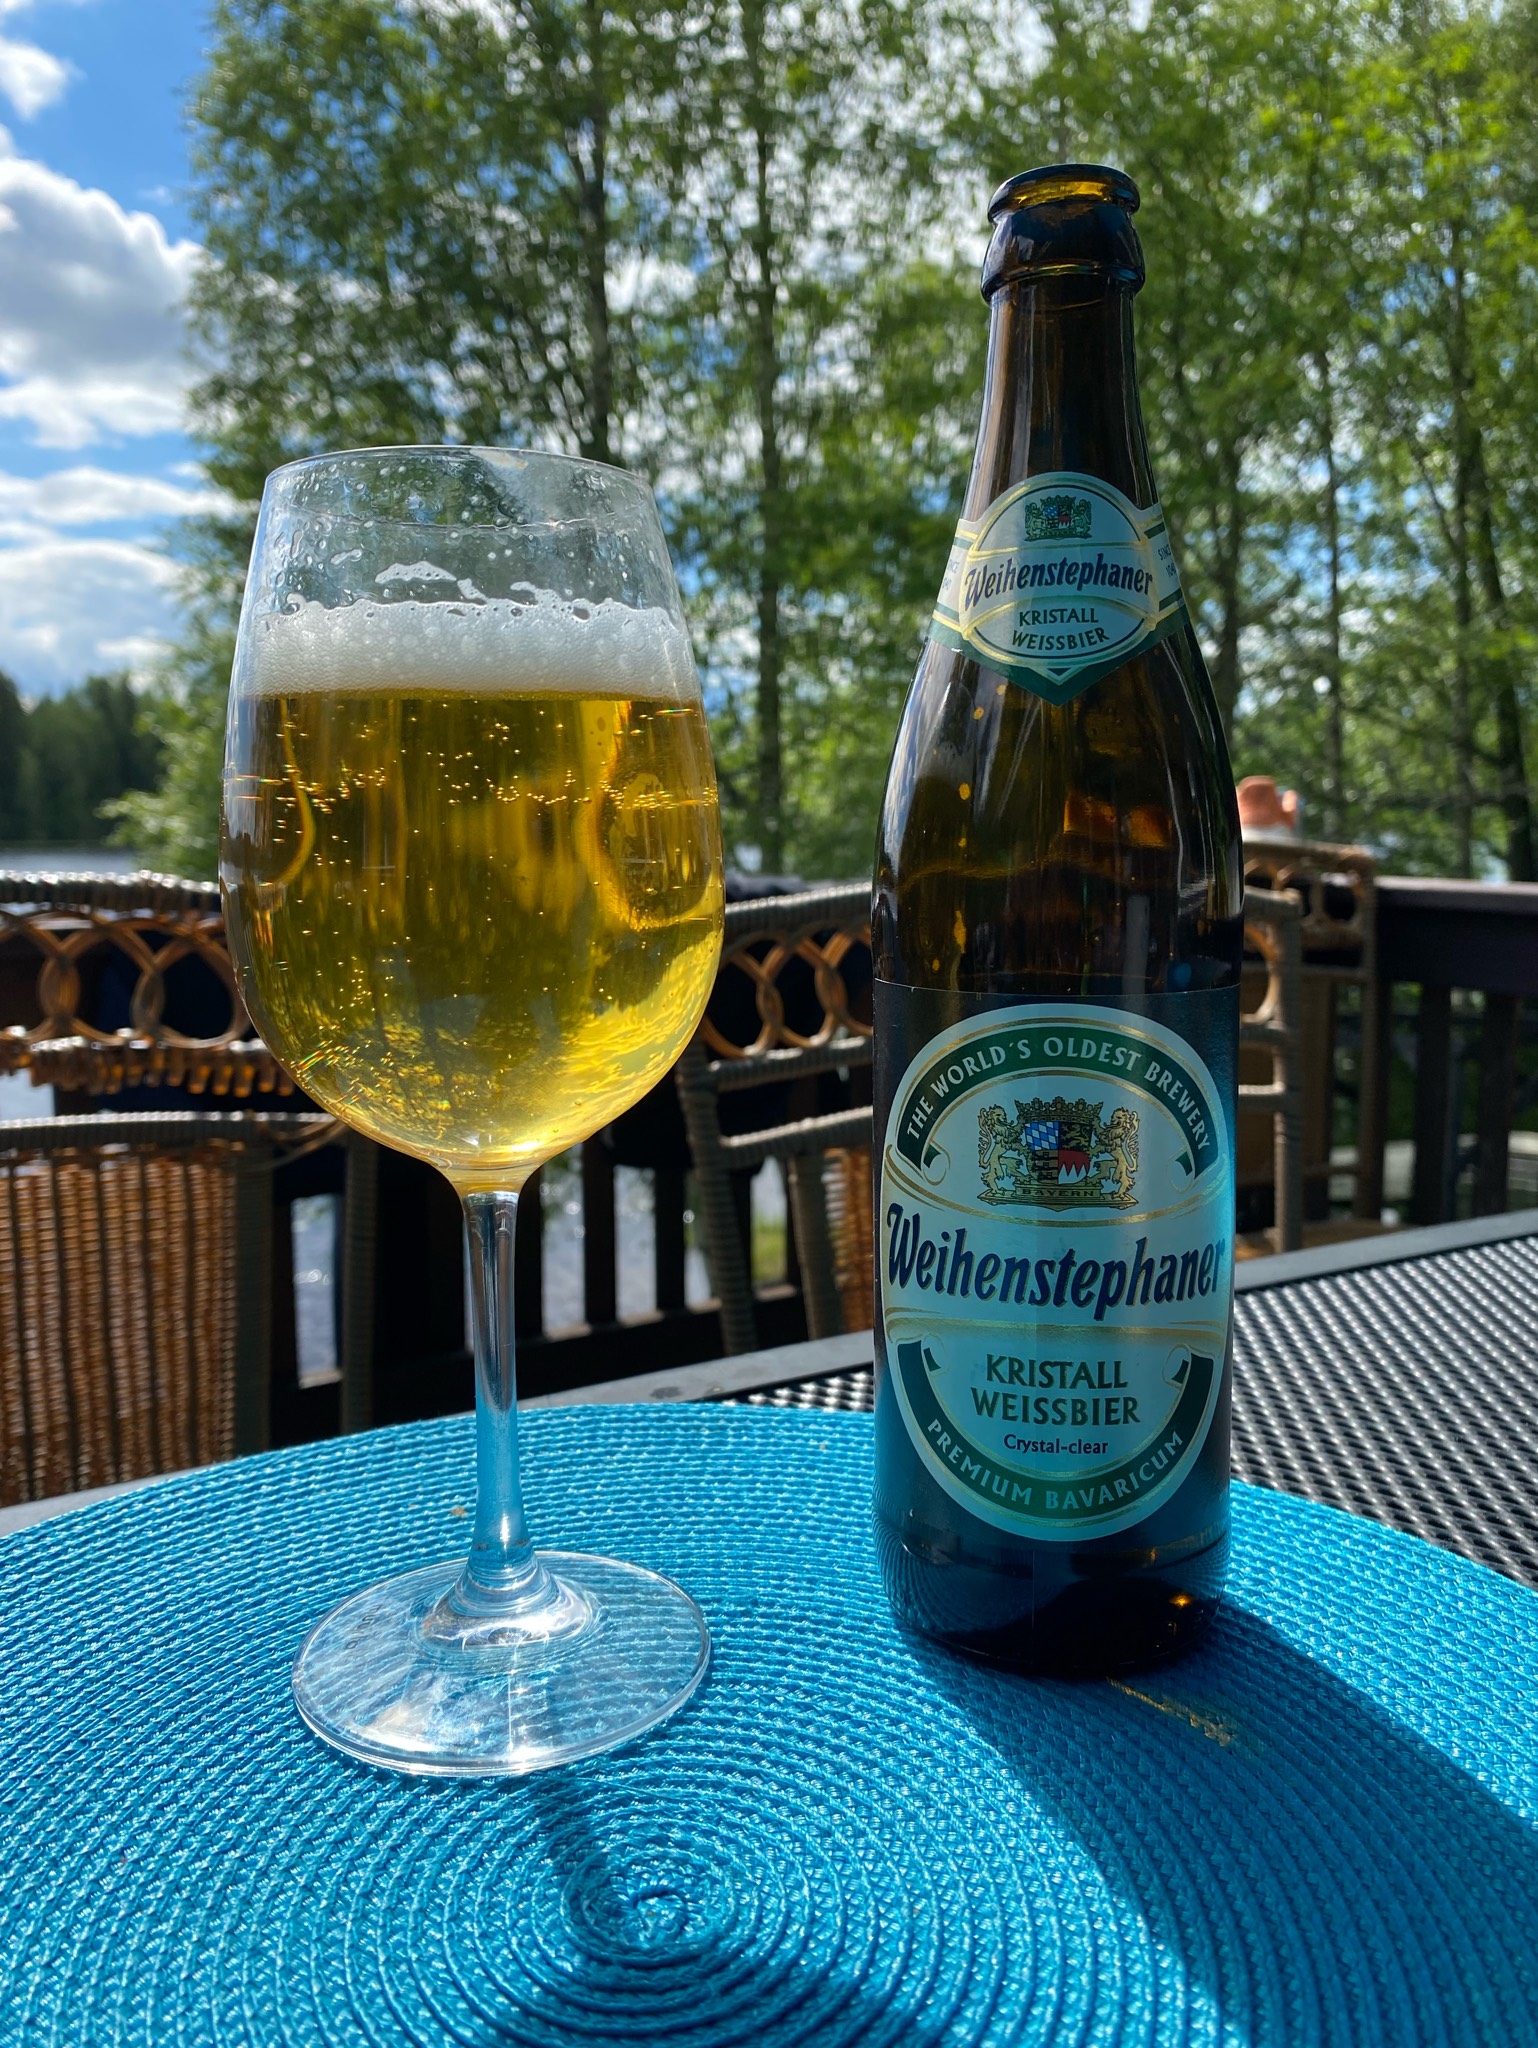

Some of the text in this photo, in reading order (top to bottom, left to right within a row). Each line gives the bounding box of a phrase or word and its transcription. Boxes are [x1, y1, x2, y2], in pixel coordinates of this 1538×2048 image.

[964, 553, 1153, 611] Weihenstephaner
[1019, 608, 1099, 627] KRISTALL
[1012, 627, 1110, 650] WEISSBIER
[906, 1101, 934, 1140] THE
[1043, 1036, 1142, 1072] OLDEST
[1144, 1062, 1211, 1150] BREWERY
[1022, 1188, 1094, 1197] BAYERN
[886, 1202, 1226, 1321] Weihenstephaner
[986, 1353, 1128, 1390] KRISTALL
[970, 1387, 1141, 1426] WEISSBIER
[1003, 1433, 1109, 1455] Crystal-clear
[927, 1418, 1184, 1510] PREMIUM BAVARICUM
